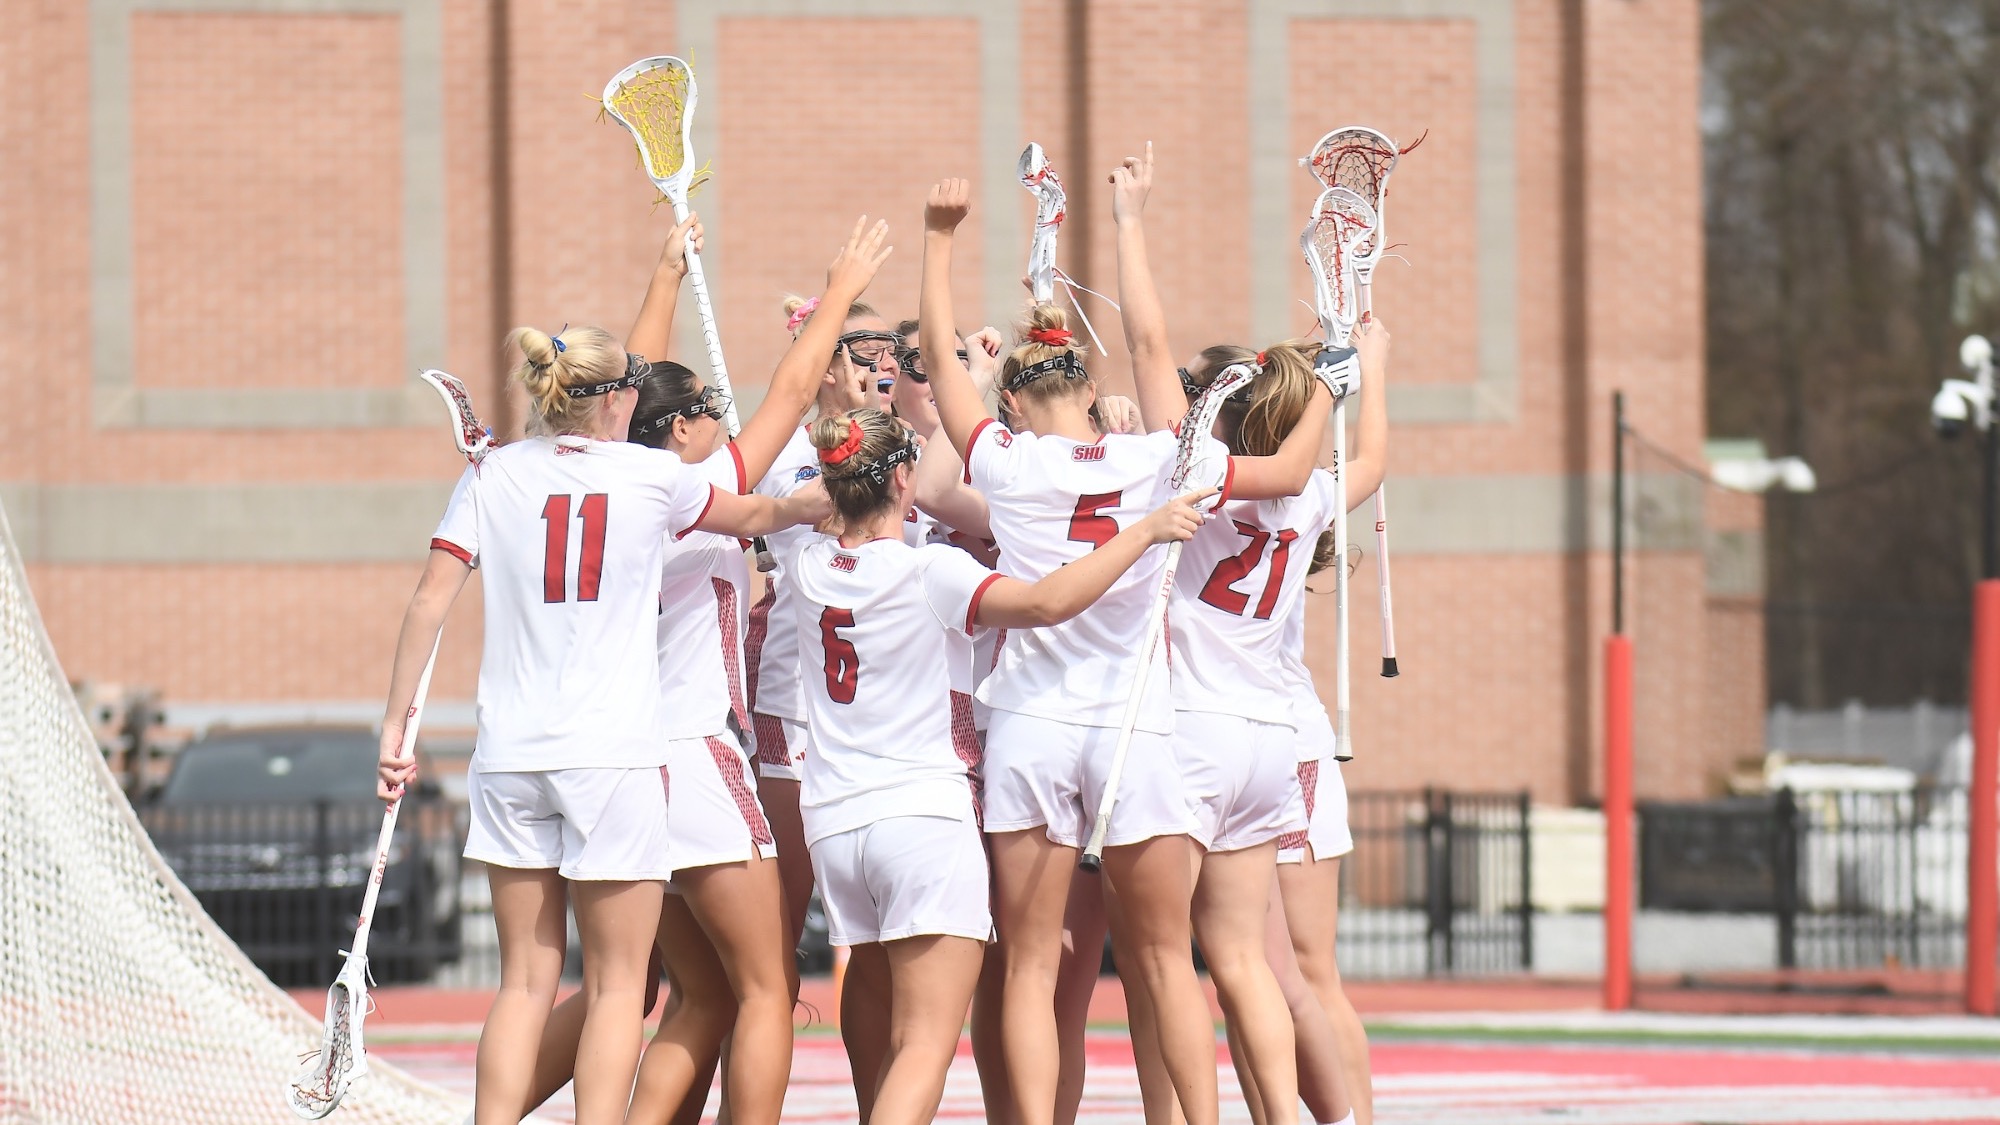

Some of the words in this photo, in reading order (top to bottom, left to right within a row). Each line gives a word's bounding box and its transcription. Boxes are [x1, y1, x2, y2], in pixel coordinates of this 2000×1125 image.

[689, 272, 742, 437] DRAGONY
[564, 386, 587, 397] TX
[595, 381, 621, 394] STX
[1183, 384, 1201, 395] TX
[1320, 371, 1341, 394] ADIDAS
[690, 403, 707, 415] ST
[887, 448, 908, 464] STX
[1072, 444, 1106, 461] SHU
[1063, 490, 1123, 560] 5
[540, 493, 608, 603] 11
[829, 553, 859, 572] SHU
[1198, 518, 1299, 620] 21
[1160, 569, 1174, 600] GAIT
[819, 605, 860, 705] 6
[374, 851, 388, 885] GAIT
